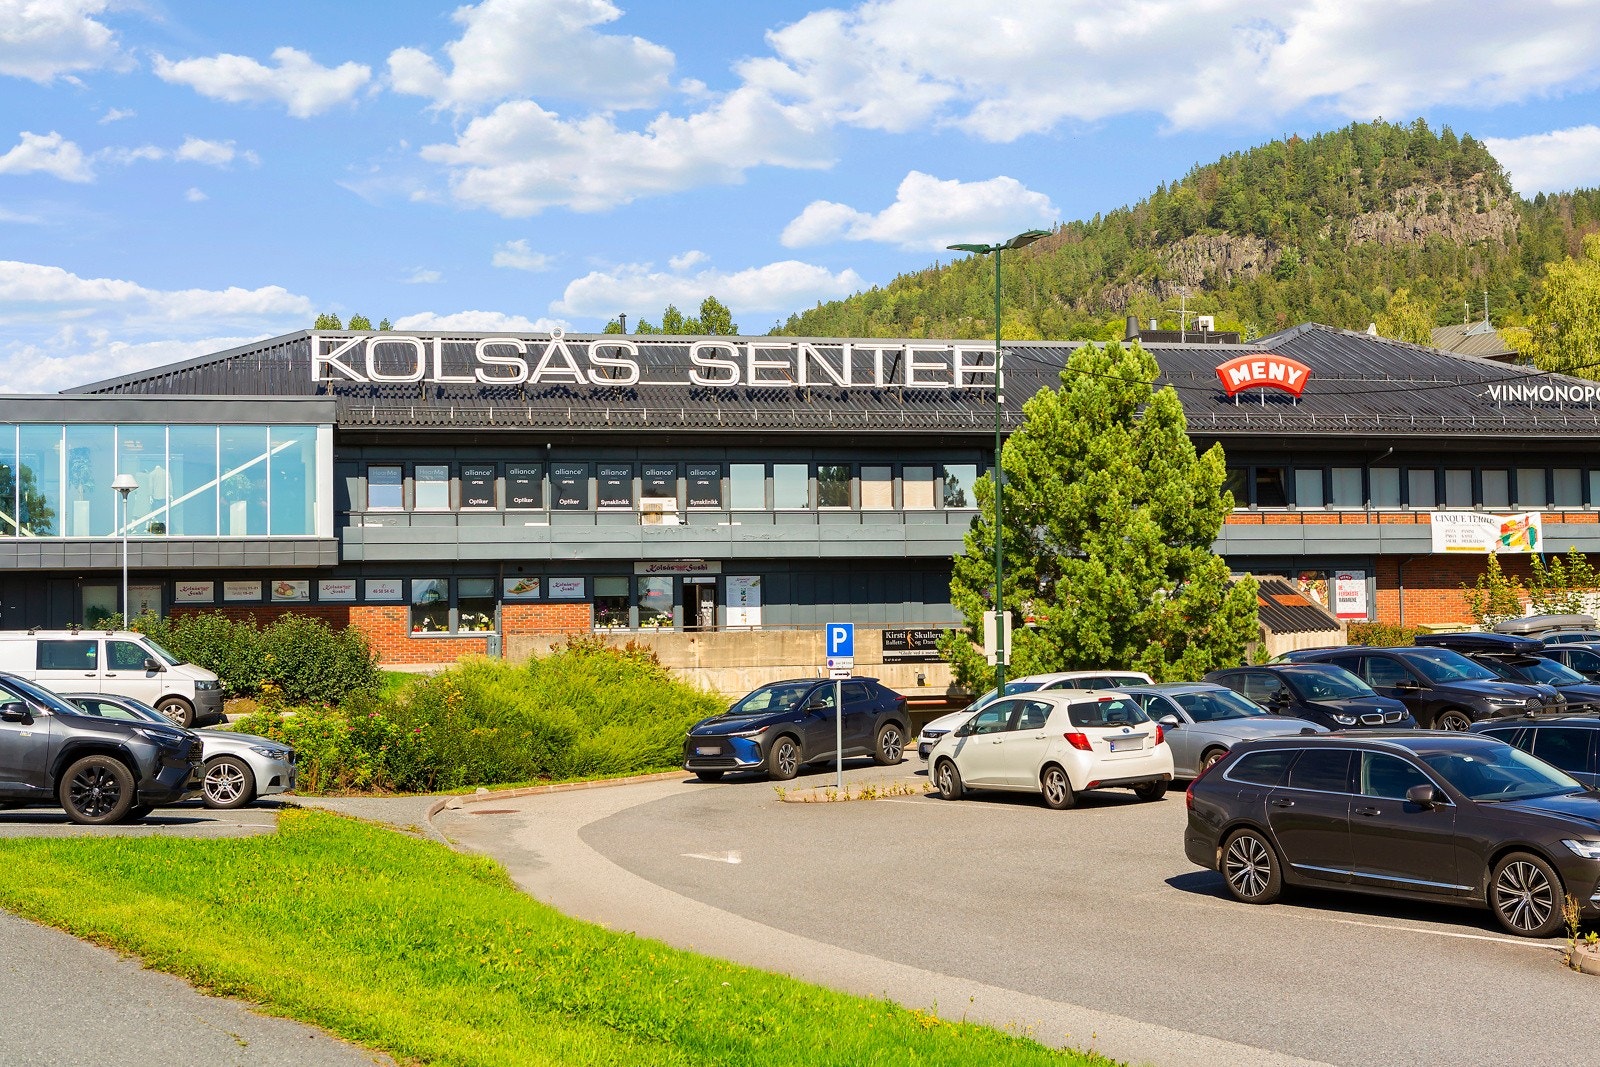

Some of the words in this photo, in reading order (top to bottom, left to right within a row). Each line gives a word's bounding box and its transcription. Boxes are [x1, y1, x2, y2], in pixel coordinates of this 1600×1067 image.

[311, 327, 640, 385] KOLSÅS
[689, 341, 1004, 388] SENTER
[1228, 361, 1303, 385] MENY
[1488, 384, 1600, 402] VINMONOP
[1435, 514, 1466, 525] CINQUE
[686, 563, 708, 572] Sushi
[832, 627, 848, 653] P
[885, 631, 906, 639] Kirsti
[914, 631, 945, 639] Skulleru
